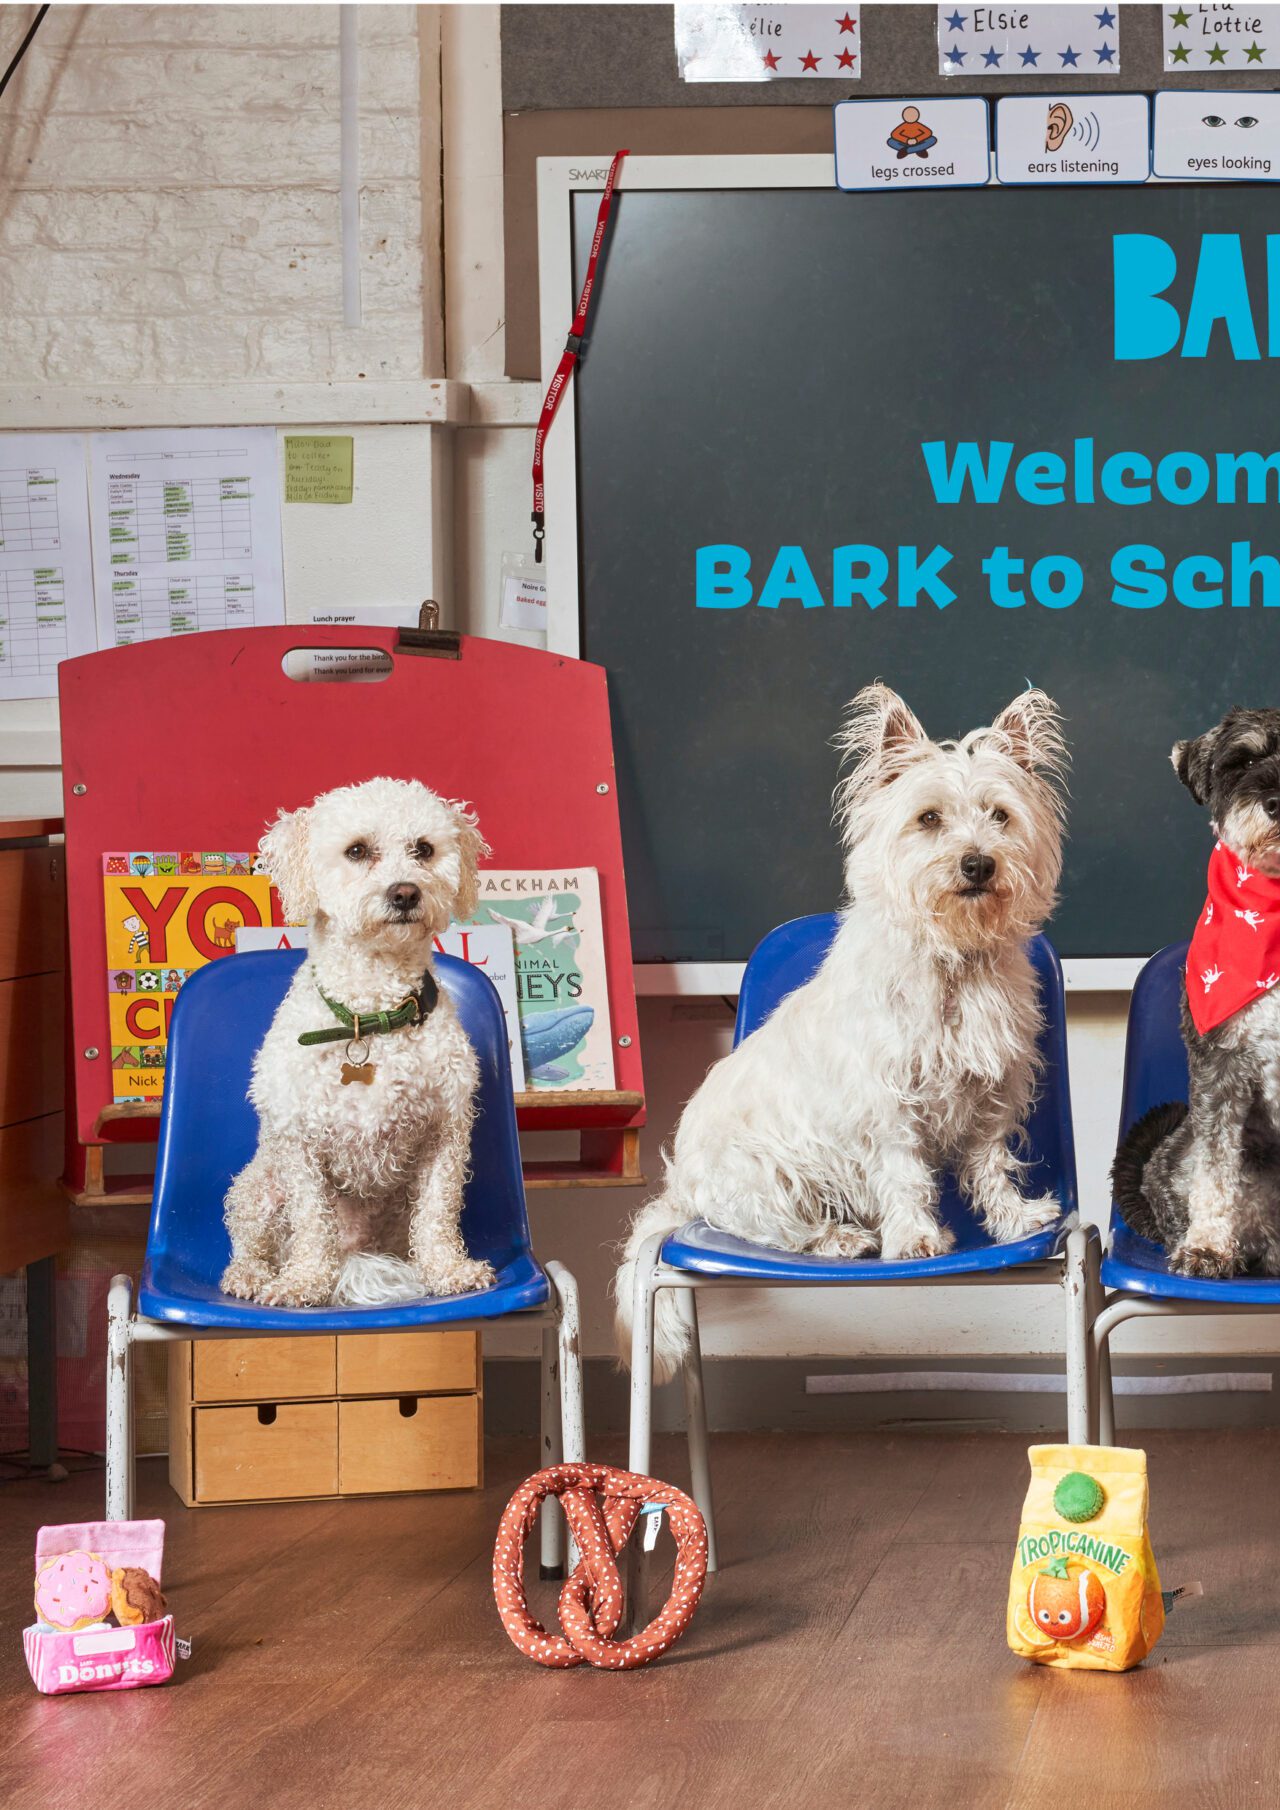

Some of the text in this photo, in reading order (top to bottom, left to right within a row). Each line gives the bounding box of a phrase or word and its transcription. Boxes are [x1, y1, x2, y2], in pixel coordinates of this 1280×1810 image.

[749, 17, 783, 37] élie
[973, 8, 1029, 33] Elsie
[1202, 17, 1263, 35] Lottie
[569, 169, 609, 180] SMART
[871, 163, 954, 179] legs crossed
[1028, 158, 1119, 175] ears listening
[1187, 156, 1271, 172] eyes looking
[591, 221, 605, 258] VISITOR
[578, 279, 592, 316] VISITOR
[545, 373, 565, 410] VISITOR
[534, 429, 544, 466] VISITOR
[120, 886, 285, 963] YO
[129, 1076, 157, 1086] Nick
[1018, 1531, 1131, 1574] TROPICANINE
[58, 1658, 154, 1685] Donuts
